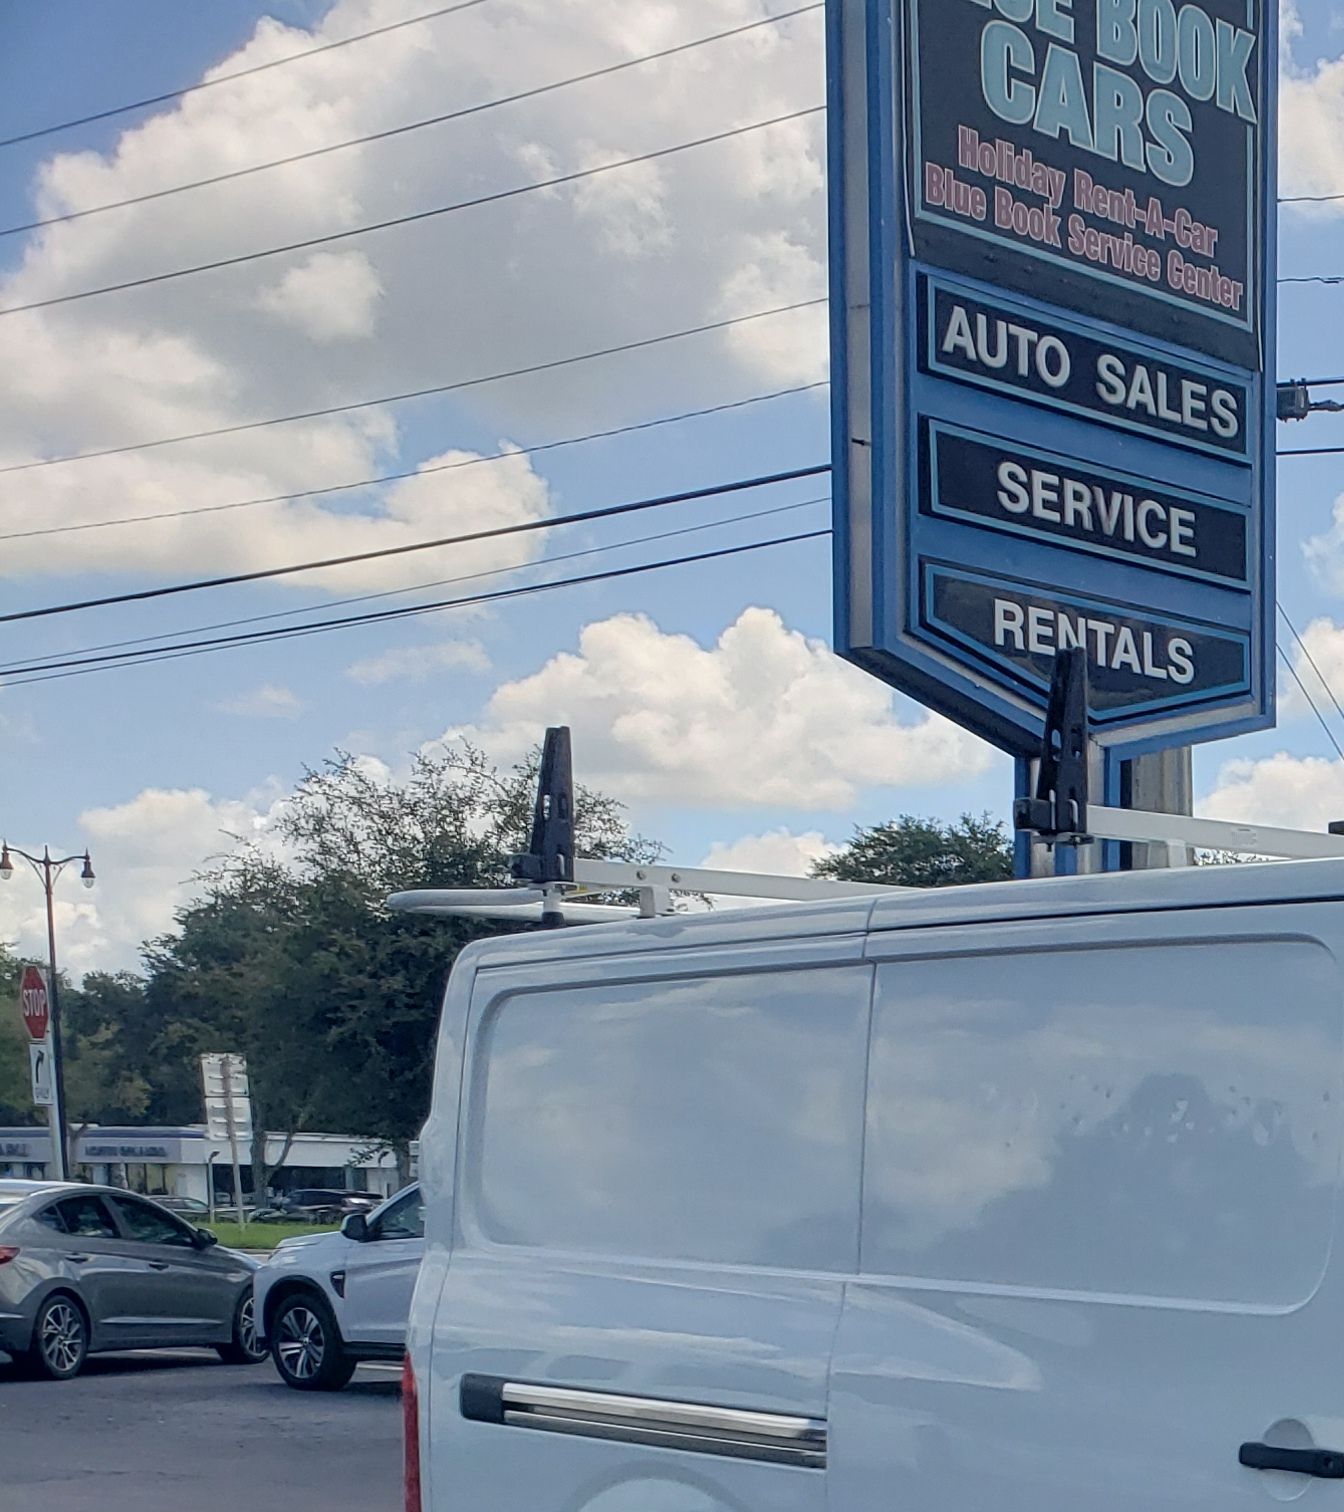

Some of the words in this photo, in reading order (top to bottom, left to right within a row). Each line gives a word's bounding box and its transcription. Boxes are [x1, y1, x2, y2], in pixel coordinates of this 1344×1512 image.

[980, 19, 1195, 187] CARS
[1096, 0, 1257, 124] BOOK
[925, 162, 987, 221] Blue
[994, 186, 1062, 248] Book
[1068, 213, 1162, 282] Service
[1167, 250, 1243, 311] Center
[958, 125, 1067, 209] Holiday
[1074, 168, 1218, 258] Rent-A-Car
[942, 305, 1071, 388] AUTO
[1096, 354, 1239, 440] SALES
[997, 460, 1197, 558] SERVICE
[993, 598, 1195, 685] RENTALS
[23, 989, 46, 1017] STOP
